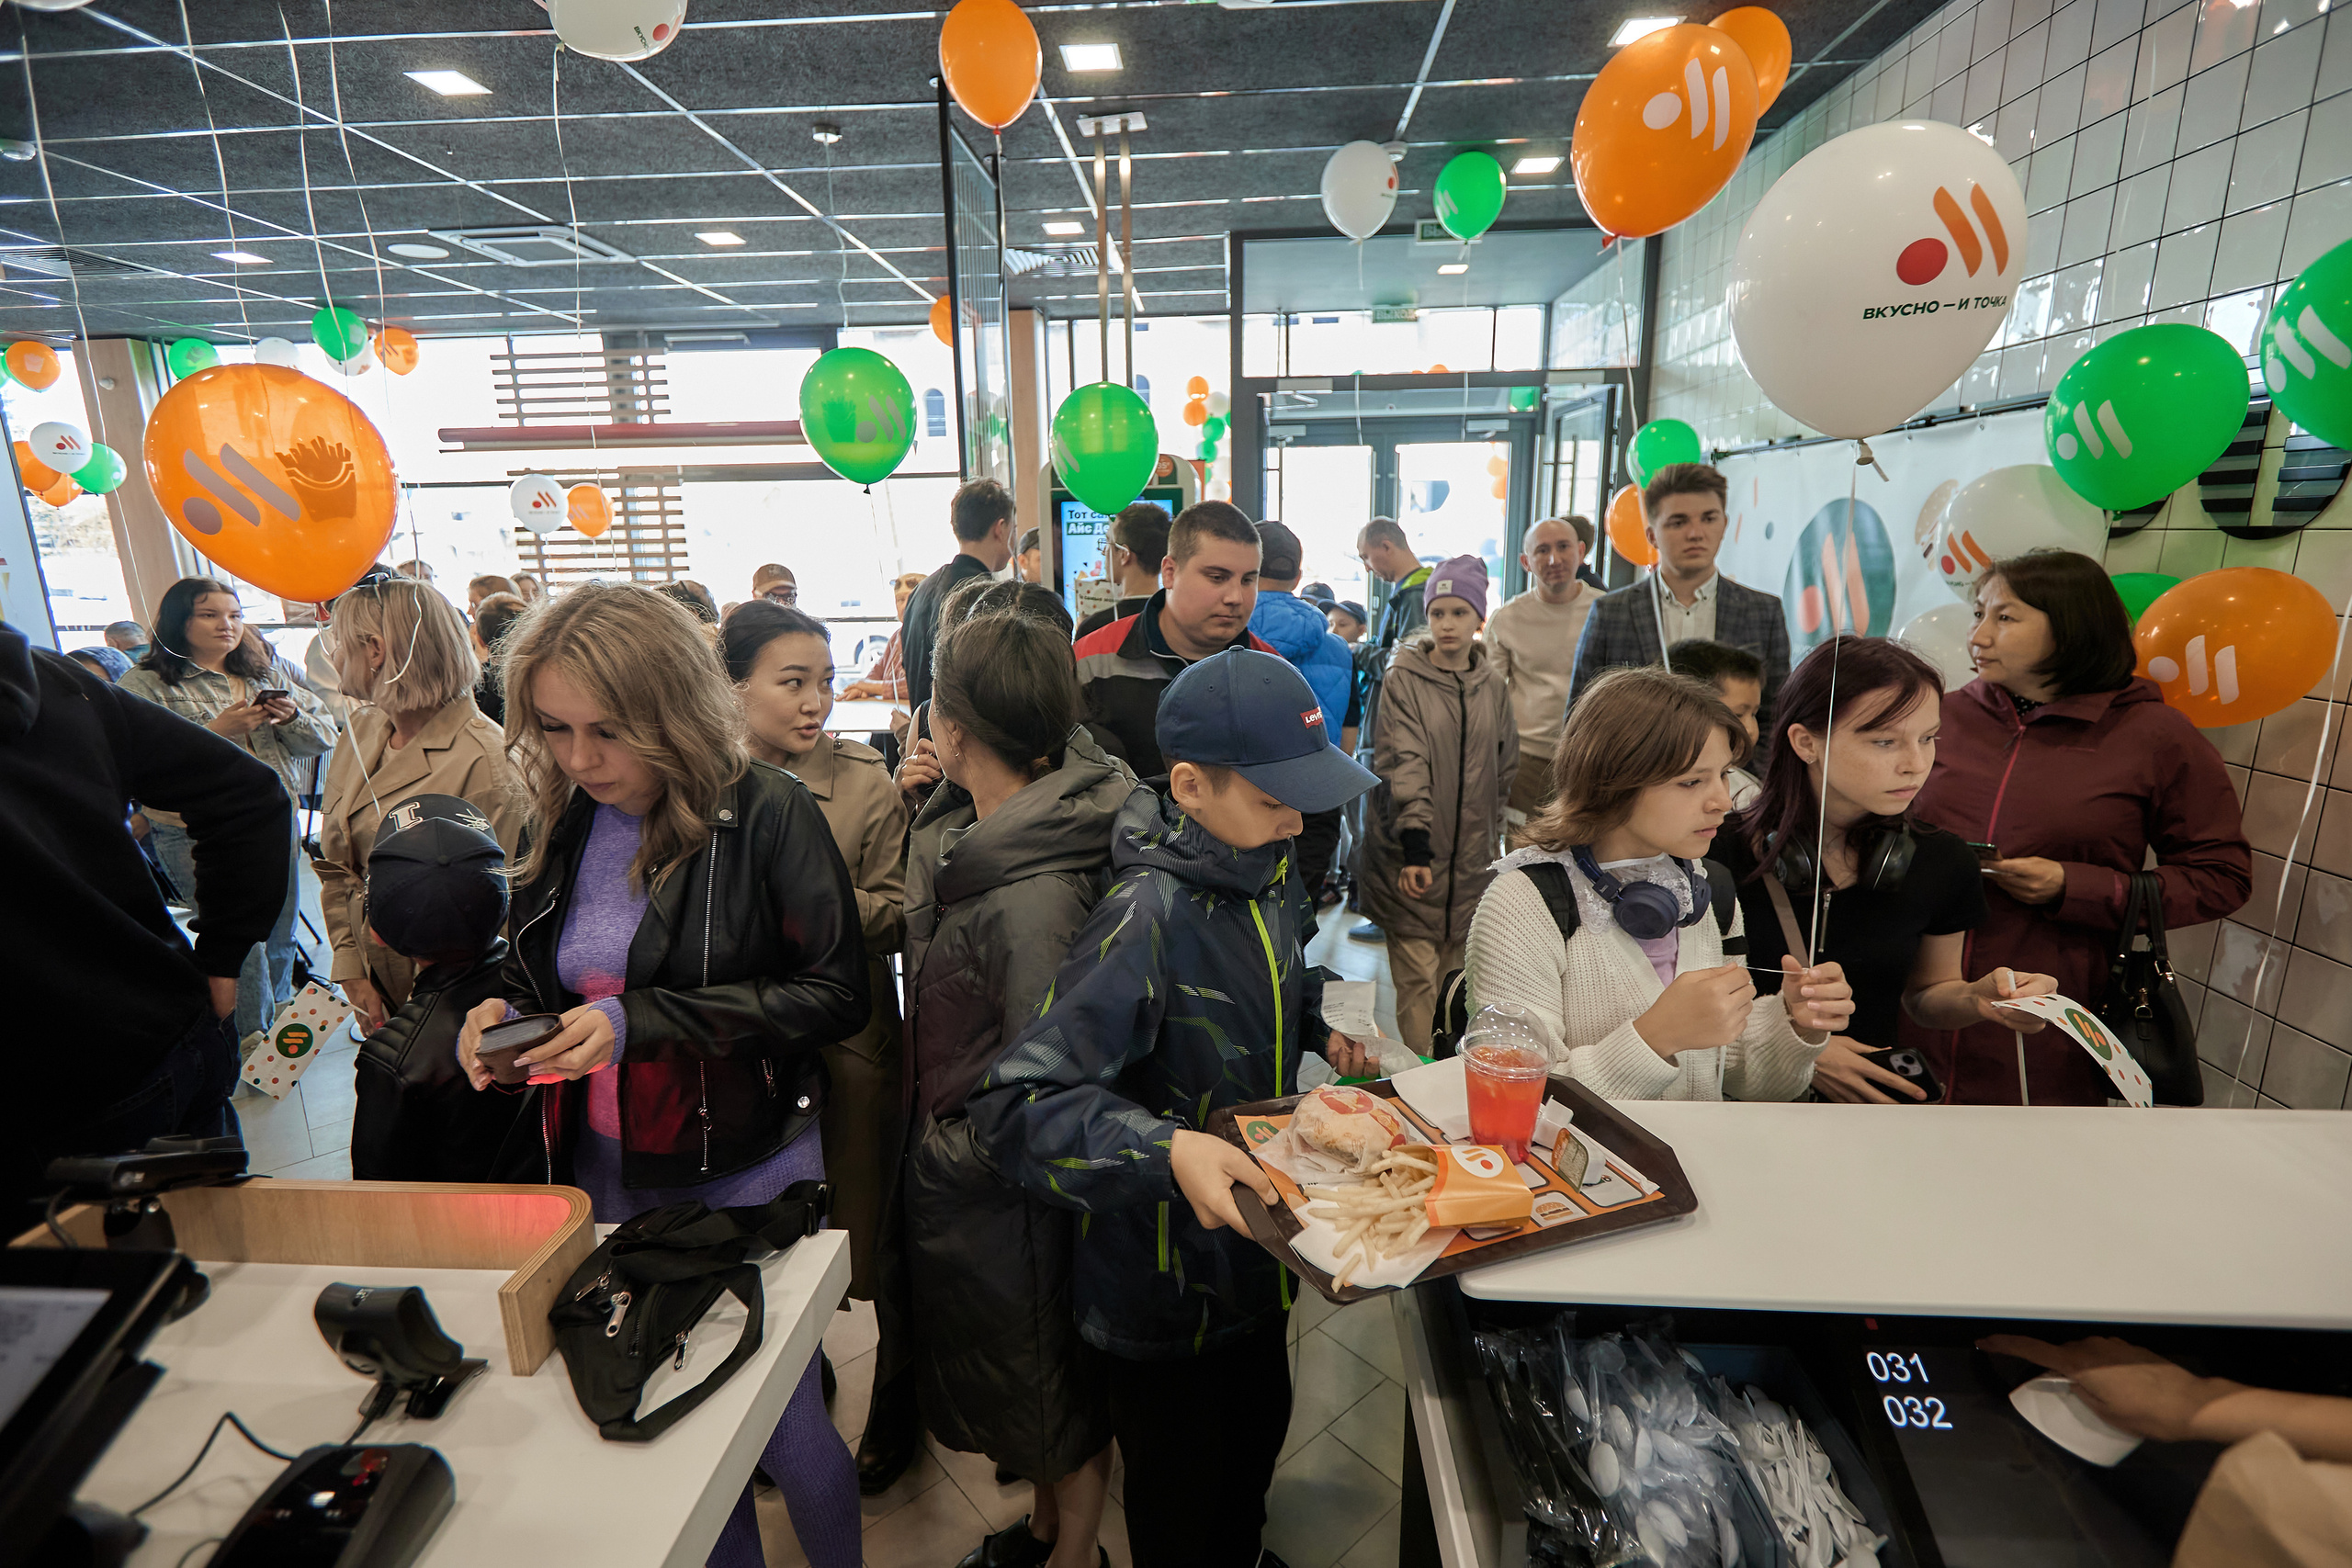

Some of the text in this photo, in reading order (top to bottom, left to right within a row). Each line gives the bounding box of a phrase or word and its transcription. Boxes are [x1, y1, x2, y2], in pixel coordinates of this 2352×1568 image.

[1862, 300, 1939, 320] ВКУСНО
[1958, 298, 1971, 310] И
[1973, 295, 2007, 310] ТОЧКА
[1068, 510, 1088, 519] Тот
[1068, 522, 1092, 535] Айс
[1866, 1351, 1929, 1383] 031
[1883, 1394, 1953, 1430] 032
